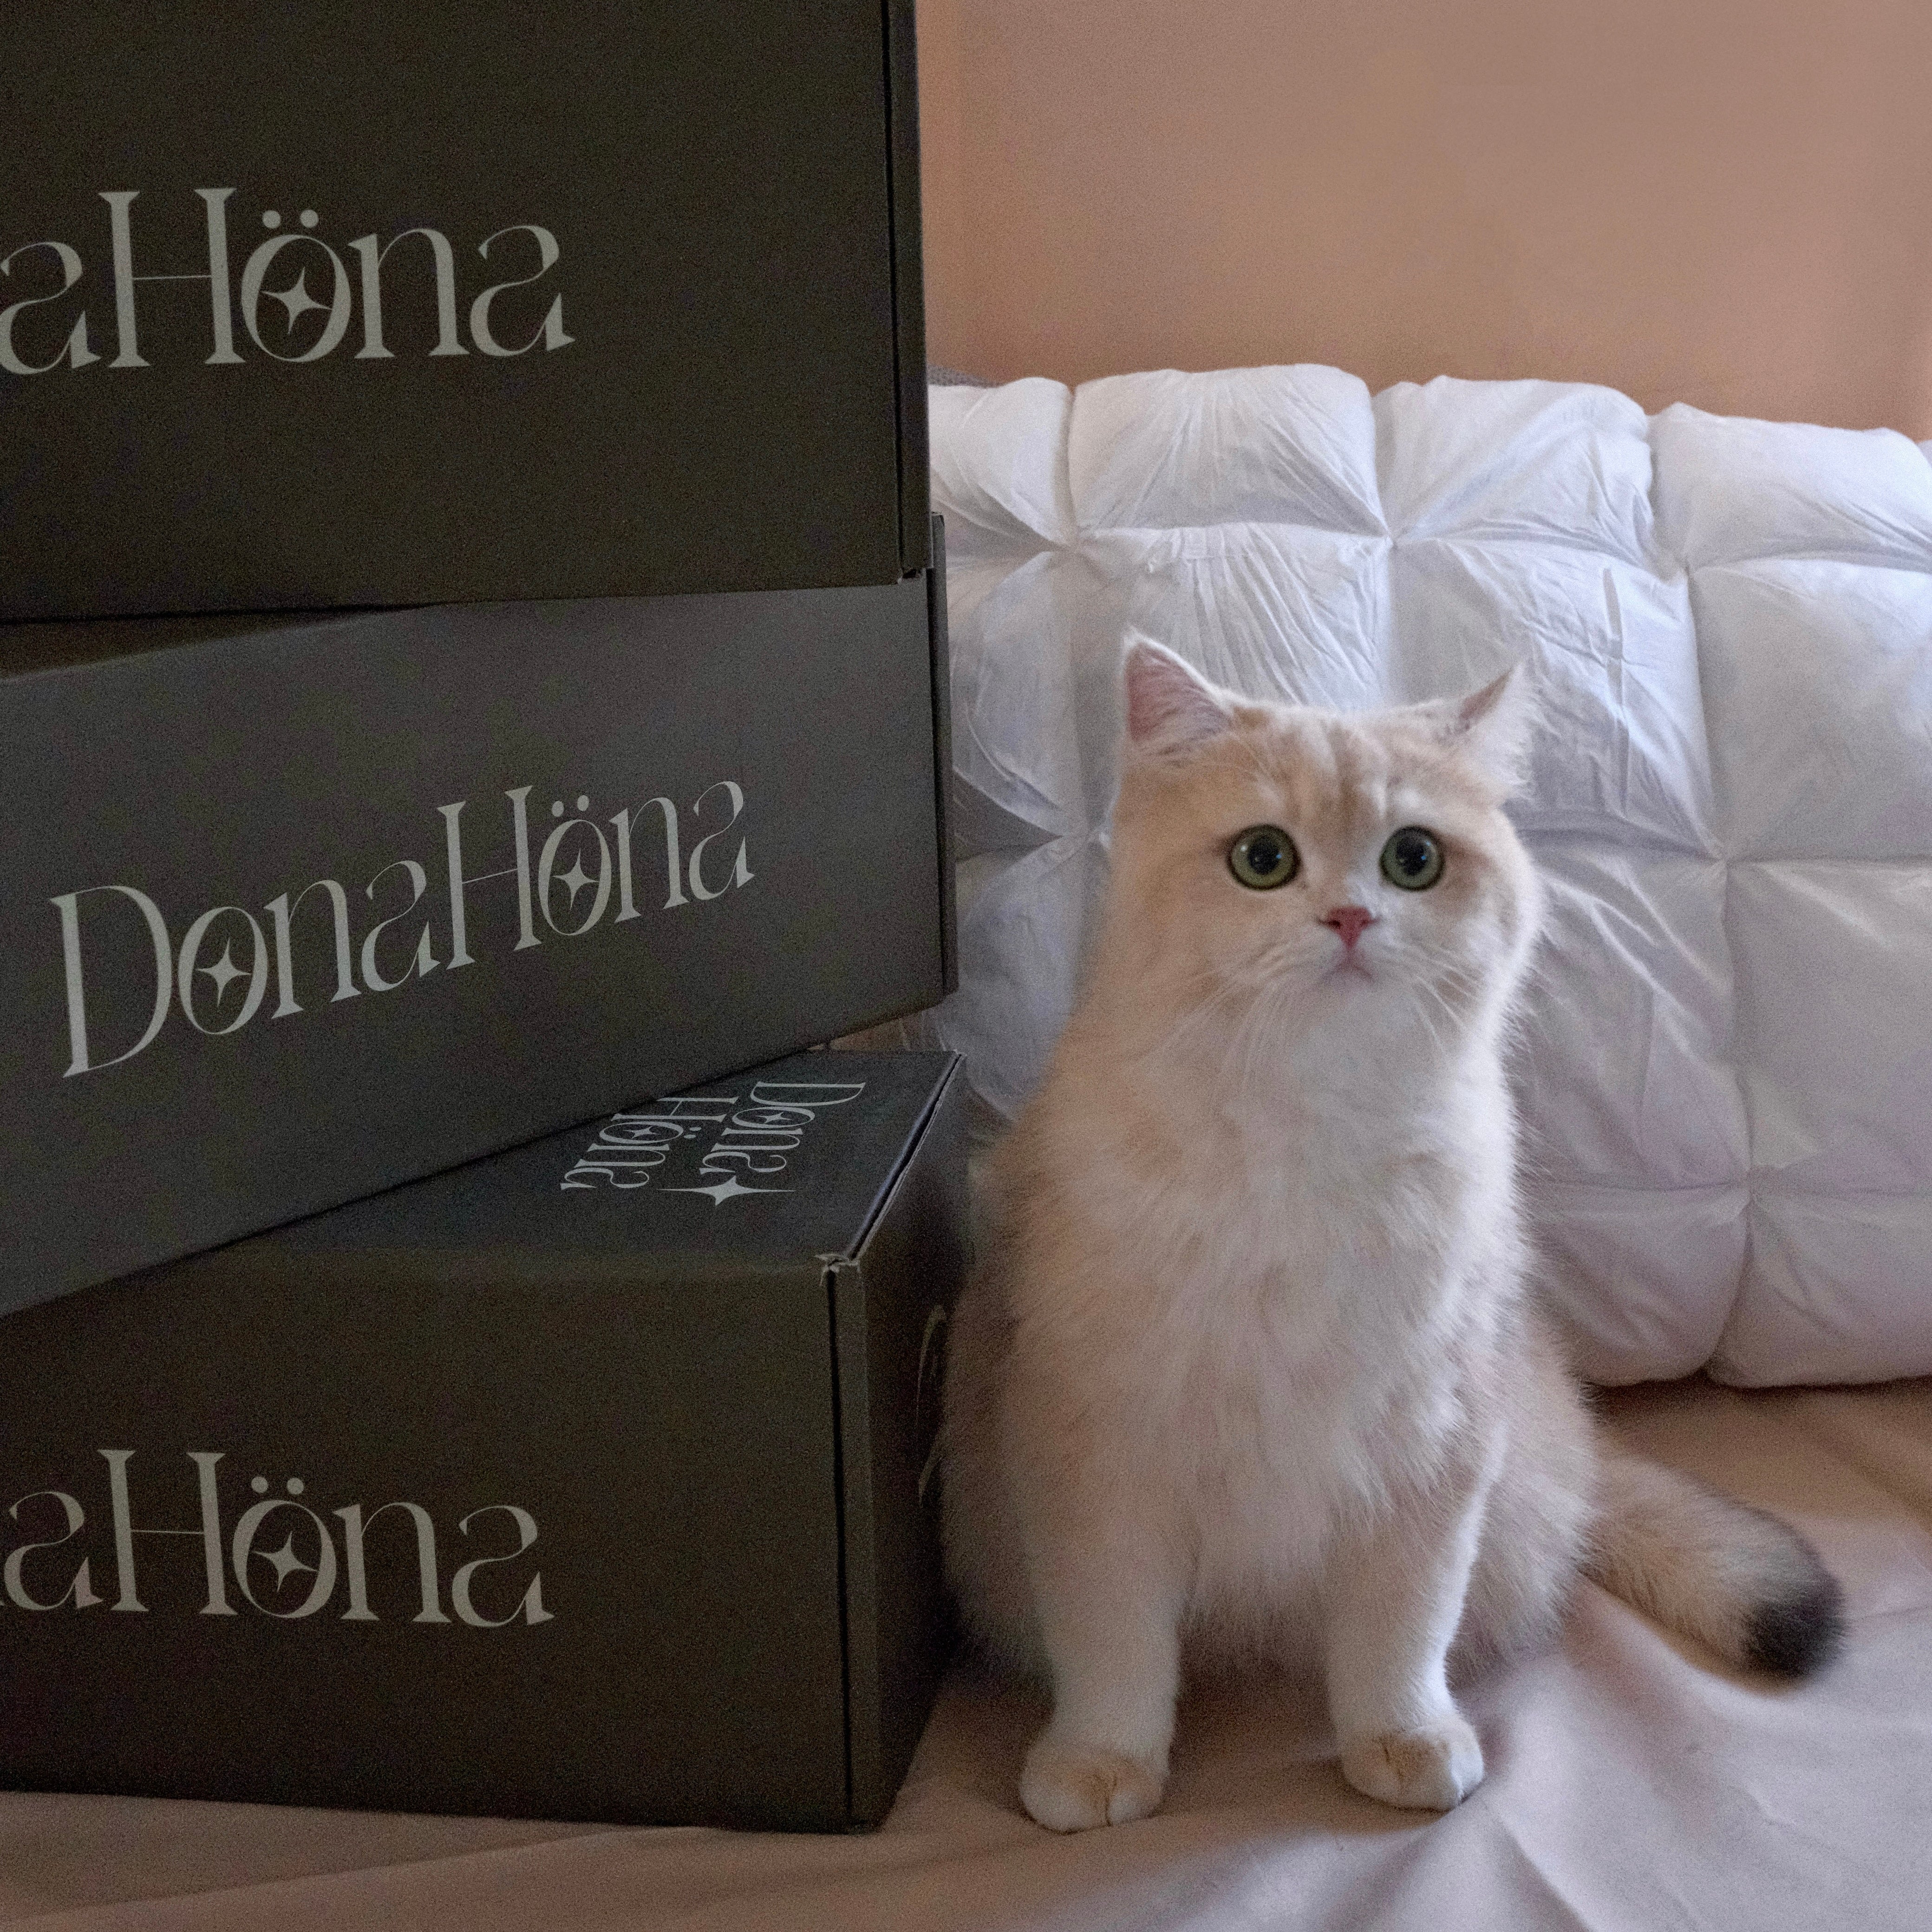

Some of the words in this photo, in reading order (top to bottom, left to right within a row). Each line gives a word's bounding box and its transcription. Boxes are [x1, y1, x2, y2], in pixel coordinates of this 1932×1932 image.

[49, 780, 756, 1078] DonaHöna
[560, 1096, 739, 1190] Höna
[699, 1081, 866, 1175] Dona
[0, 1449, 555, 1628] aHöna
